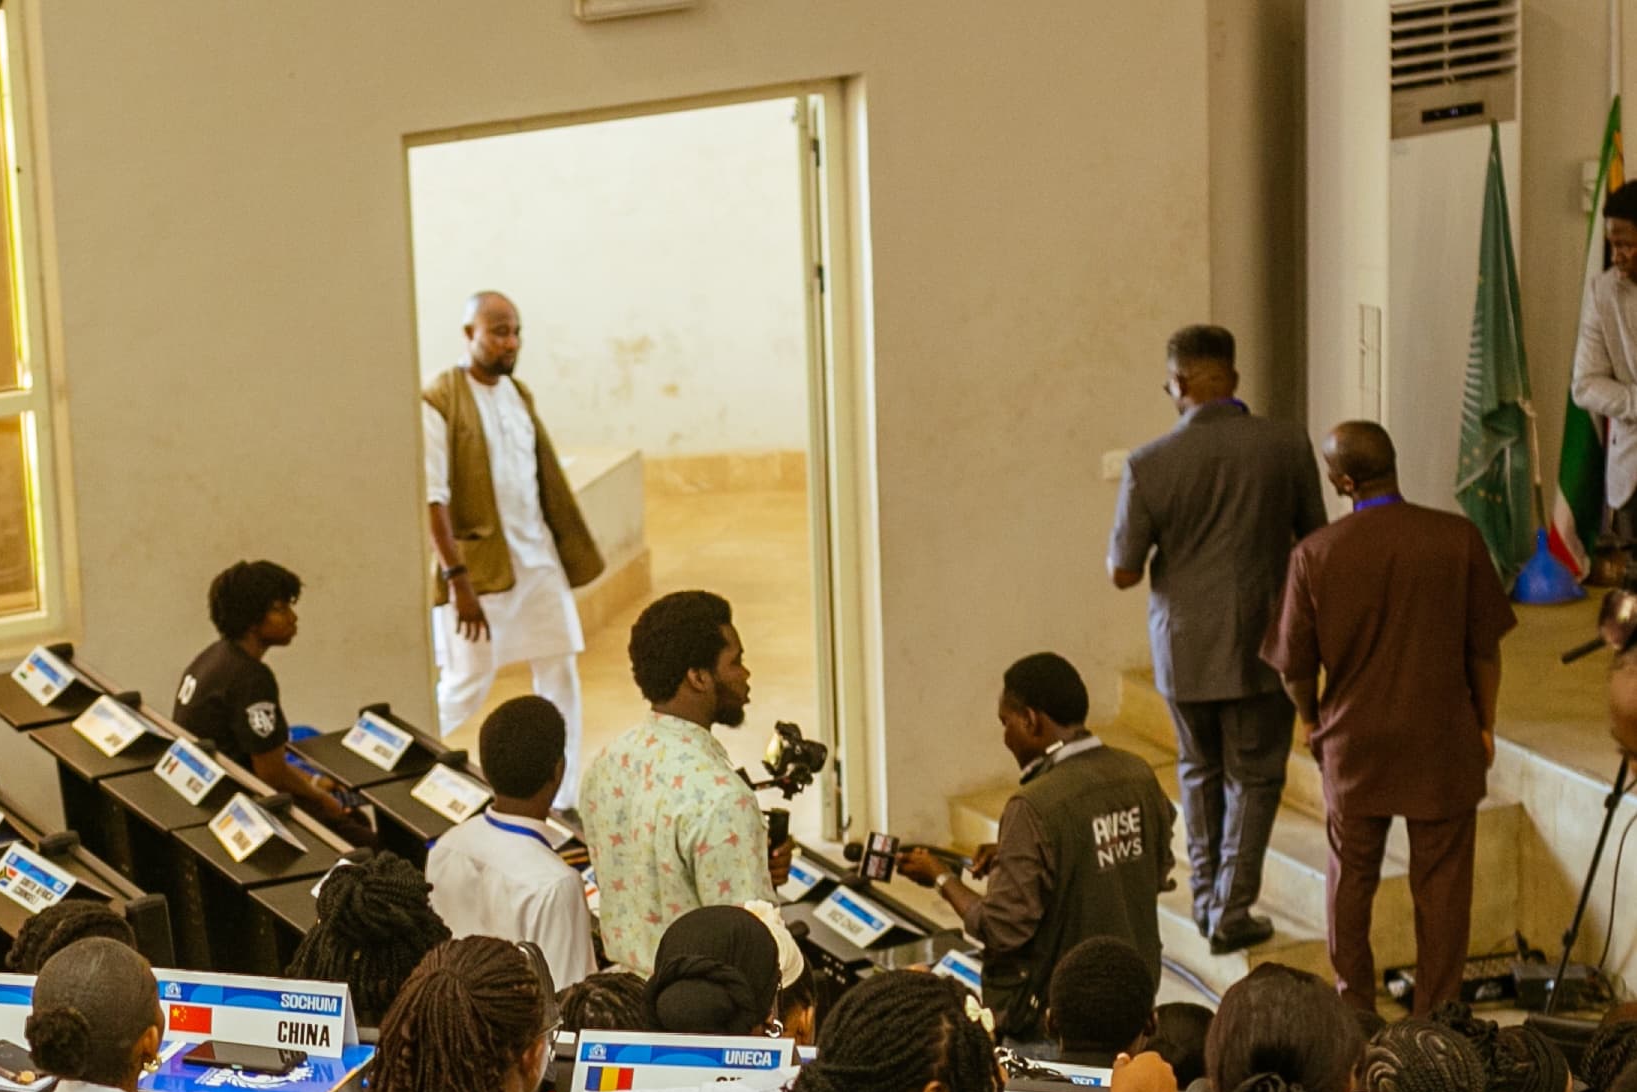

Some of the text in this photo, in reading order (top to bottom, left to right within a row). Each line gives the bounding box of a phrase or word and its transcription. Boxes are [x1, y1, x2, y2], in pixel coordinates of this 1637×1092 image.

[280, 993, 337, 1013] SOCHUM
[277, 1020, 331, 1048] CHINA
[724, 1050, 773, 1067] UNECA
